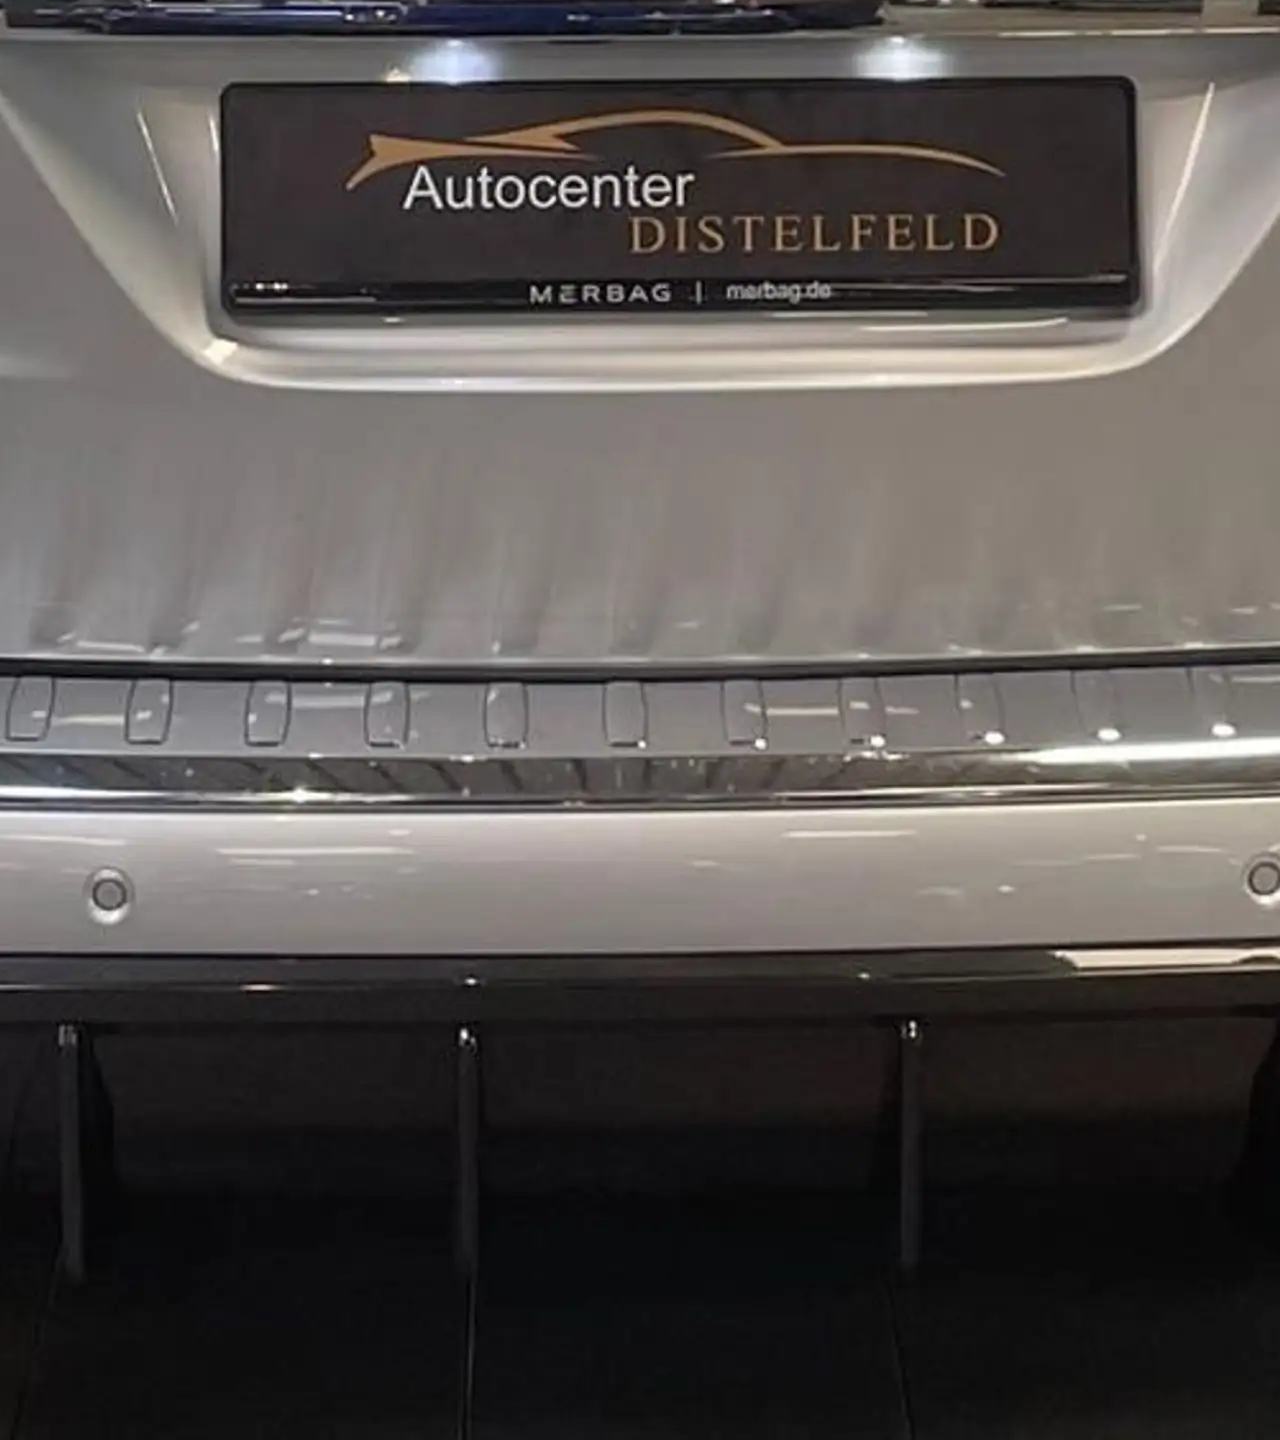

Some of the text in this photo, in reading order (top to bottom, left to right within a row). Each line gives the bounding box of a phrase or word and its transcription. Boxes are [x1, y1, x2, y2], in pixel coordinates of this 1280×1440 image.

[402, 164, 696, 211] Autocenter
[628, 213, 1000, 254] DISTELFELD
[528, 280, 833, 305] MERBAG merbag.de
